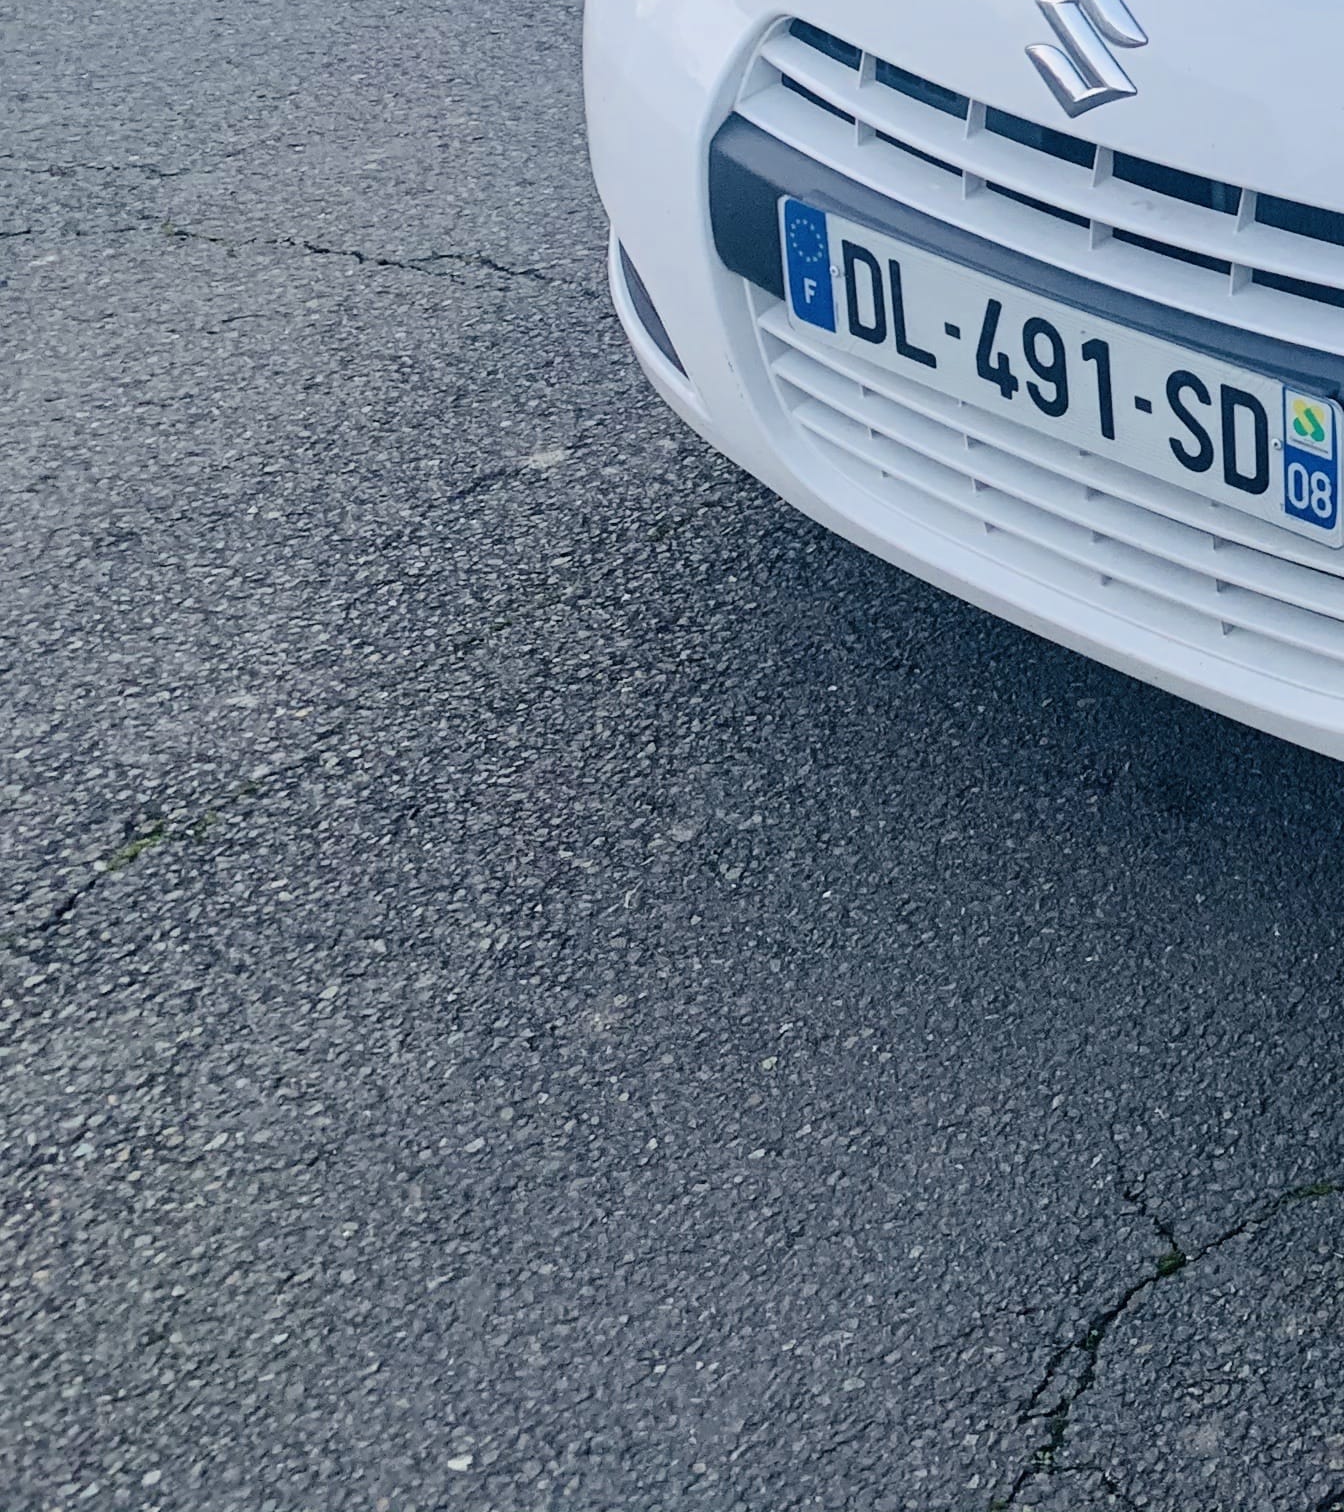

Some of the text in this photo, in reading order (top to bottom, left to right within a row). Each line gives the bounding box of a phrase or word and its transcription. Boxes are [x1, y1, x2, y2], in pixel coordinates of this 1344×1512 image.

[803, 277, 817, 304] F
[841, 239, 1271, 495] DL-491-SD
[1287, 462, 1333, 519] 08
